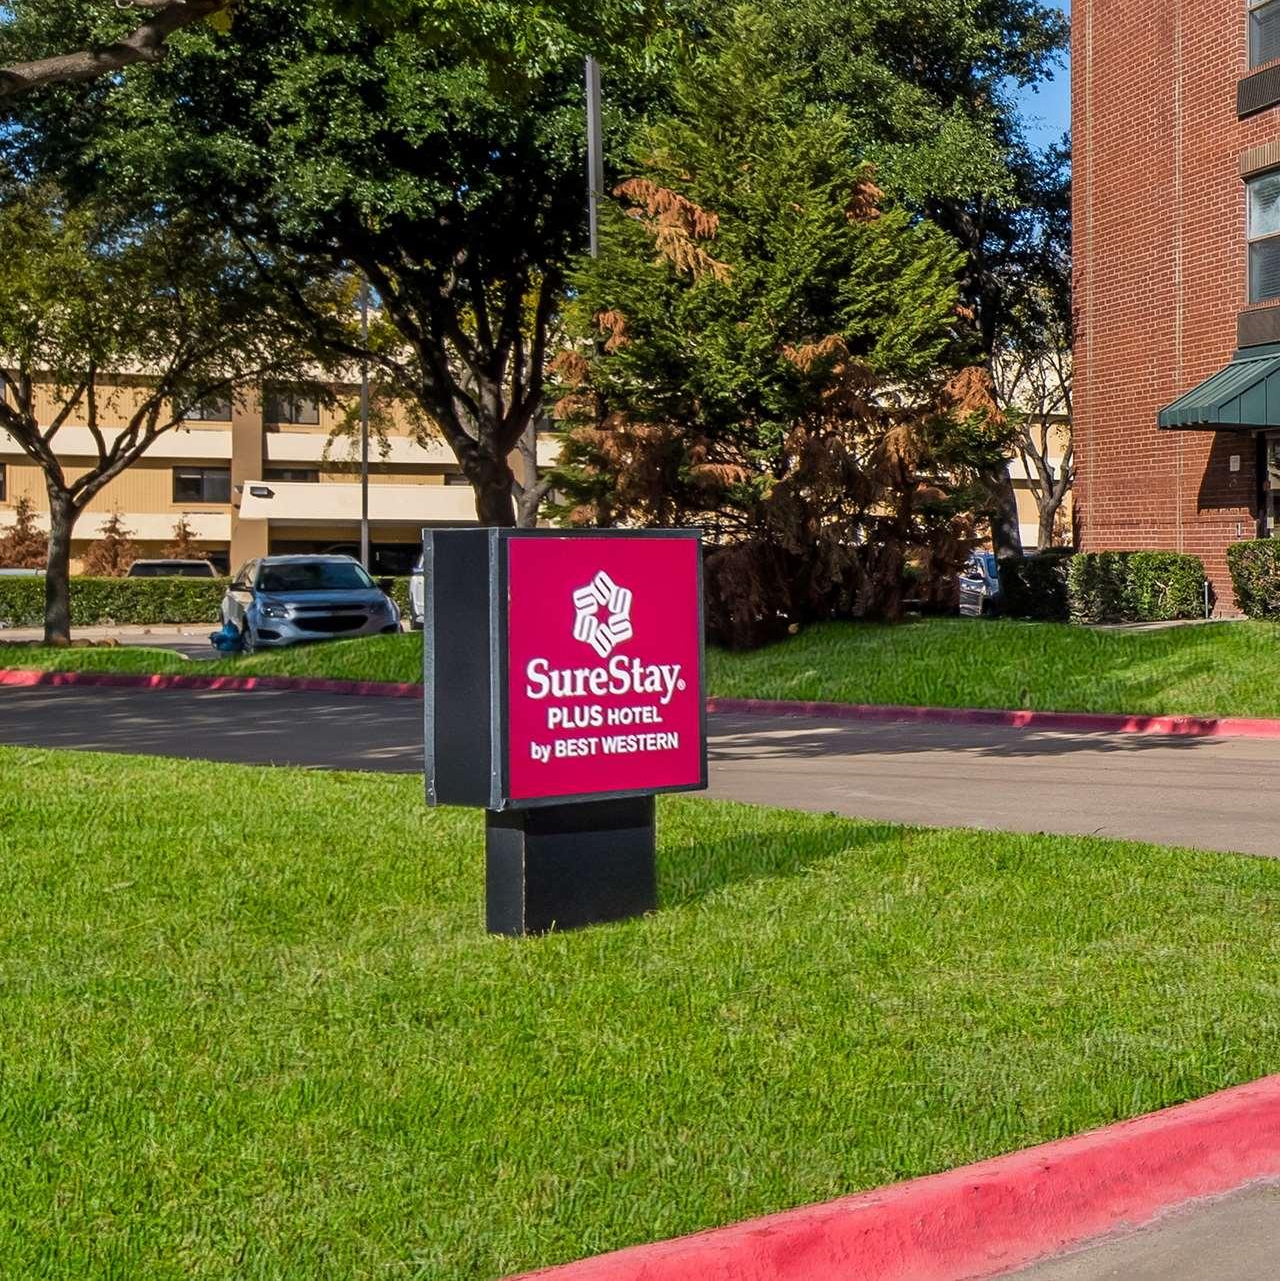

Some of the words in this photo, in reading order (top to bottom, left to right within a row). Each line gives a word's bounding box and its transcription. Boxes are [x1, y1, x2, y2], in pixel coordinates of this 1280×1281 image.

[547, 705, 604, 730] PLUS
[607, 705, 663, 726] HOTEL
[530, 741, 551, 763] by
[554, 737, 599, 758] BEST
[601, 731, 679, 755] WESTERN
